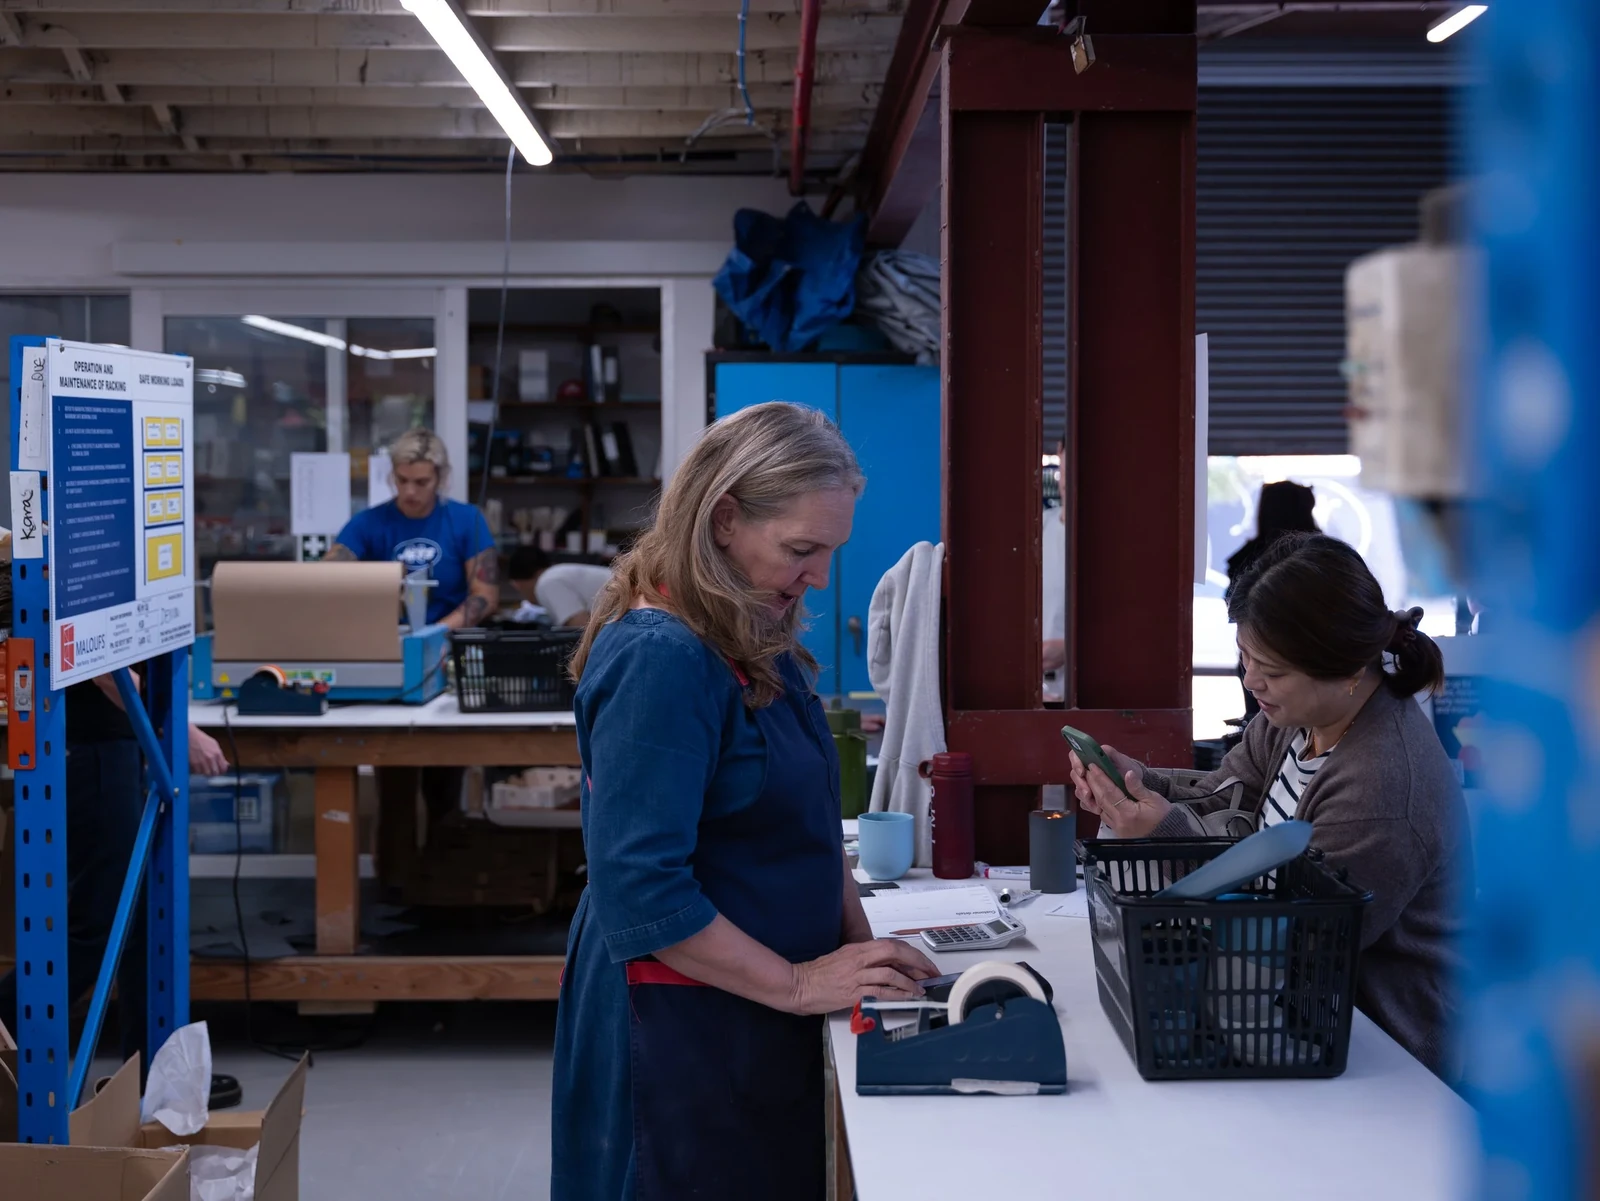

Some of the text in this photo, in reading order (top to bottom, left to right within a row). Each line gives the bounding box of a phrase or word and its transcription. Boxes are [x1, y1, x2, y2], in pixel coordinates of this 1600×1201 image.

[74, 361, 113, 375] OPERATION AND
[59, 376, 126, 391] MAINTENANCE OF RACKING
[139, 373, 150, 385] SAFE
[76, 634, 105, 656] MALOUFS
